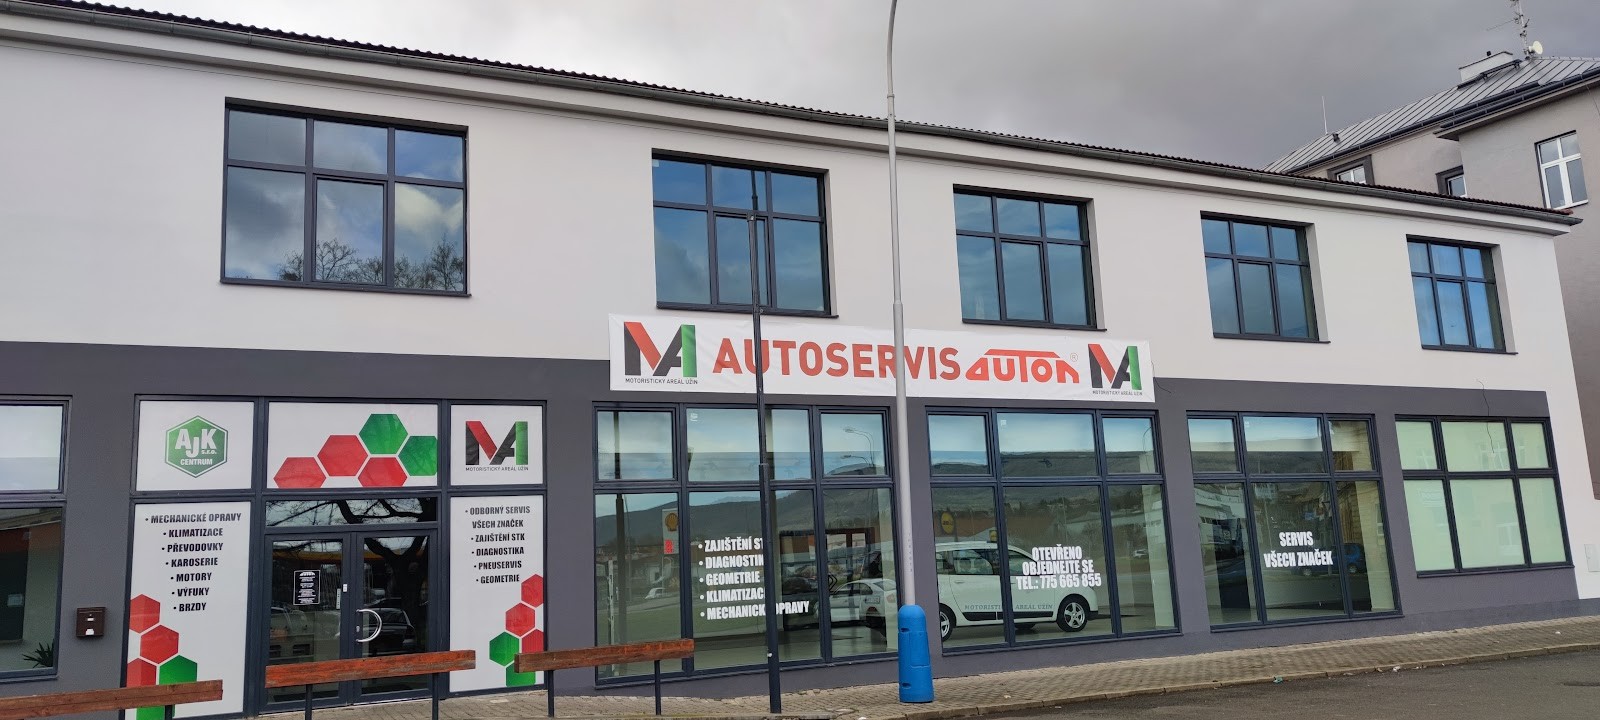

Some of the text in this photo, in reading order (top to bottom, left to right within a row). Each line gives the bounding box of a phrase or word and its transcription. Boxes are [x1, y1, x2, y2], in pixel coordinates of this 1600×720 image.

[712, 337, 961, 381] AUTOSERVIS
[174, 428, 217, 458] AJK
[180, 458, 213, 466] CENTRUM
[469, 505, 531, 515] ODBORNÝ SERVIS
[150, 513, 242, 524] MECHANICKÉ OPRAVY
[472, 519, 524, 529] VŠECH ZNAČEK
[168, 528, 223, 538] KLIMATIZACE
[475, 532, 525, 543] ZAJIŠTĚNÍ STK
[704, 536, 753, 553] ZAJIŠTĚNÍ
[1278, 531, 1314, 547] SERVIS
[167, 542, 224, 553] PŘEVODOVKY
[476, 546, 525, 557] DIAGNOSTIKA
[1031, 543, 1083, 562] OTEVŘENO
[171, 557, 219, 568] KAROSERIE
[1263, 548, 1334, 568] VŠECH ZNAČEK
[478, 560, 522, 570] PNEUSERVIS
[1022, 559, 1094, 576] OBJEDNEJTE SE
[176, 572, 212, 582] MOTORY
[480, 574, 520, 584] GEOMETRIE
[705, 571, 760, 586] GEOMETRIE
[1039, 574, 1058, 589] 775
[1060, 573, 1080, 588] 665
[1081, 572, 1102, 587] 855
[177, 587, 210, 597] VÝFUKY
[706, 587, 765, 603] KLIMATIZAC
[179, 602, 207, 612] BRZDY
[706, 604, 766, 620] MECHANICK
